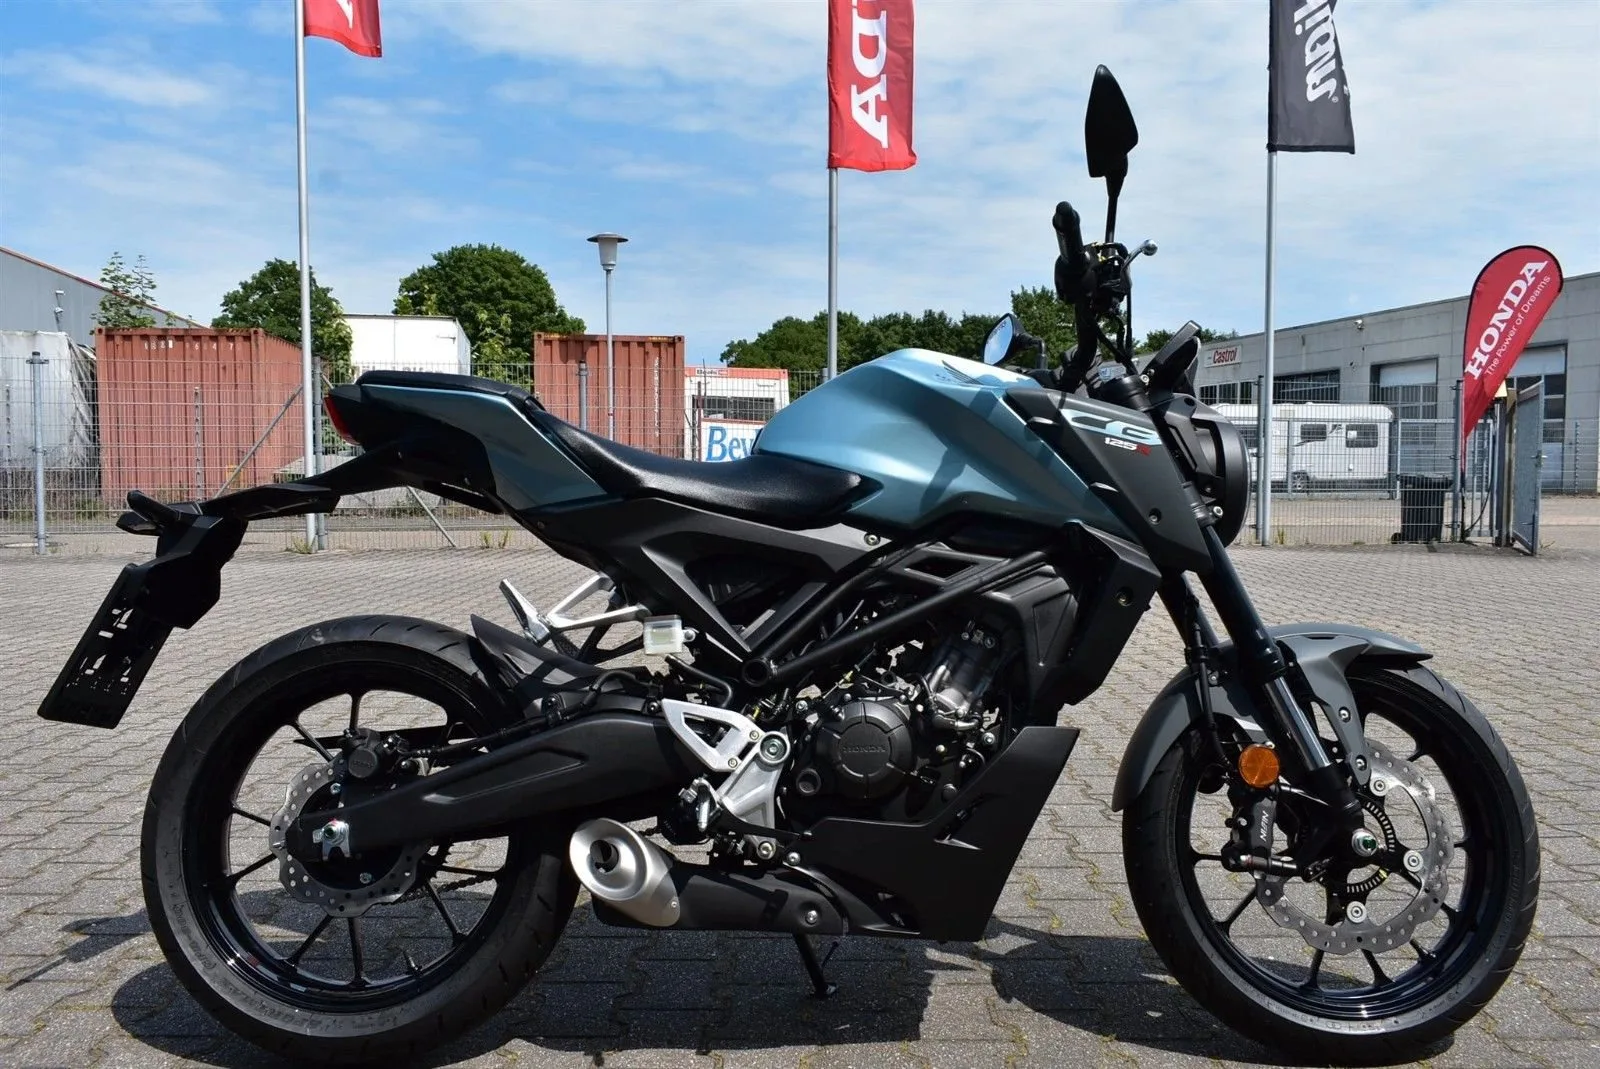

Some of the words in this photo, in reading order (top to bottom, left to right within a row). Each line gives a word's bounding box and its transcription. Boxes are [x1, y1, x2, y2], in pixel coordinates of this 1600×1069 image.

[1464, 260, 1548, 380] HONDA
[1485, 357, 1500, 375] The
[1496, 325, 1518, 357] Power
[1516, 312, 1525, 326] of
[1521, 275, 1551, 313] Dreams
[1212, 347, 1238, 364] Castrol
[842, 744, 886, 753] HONDA
